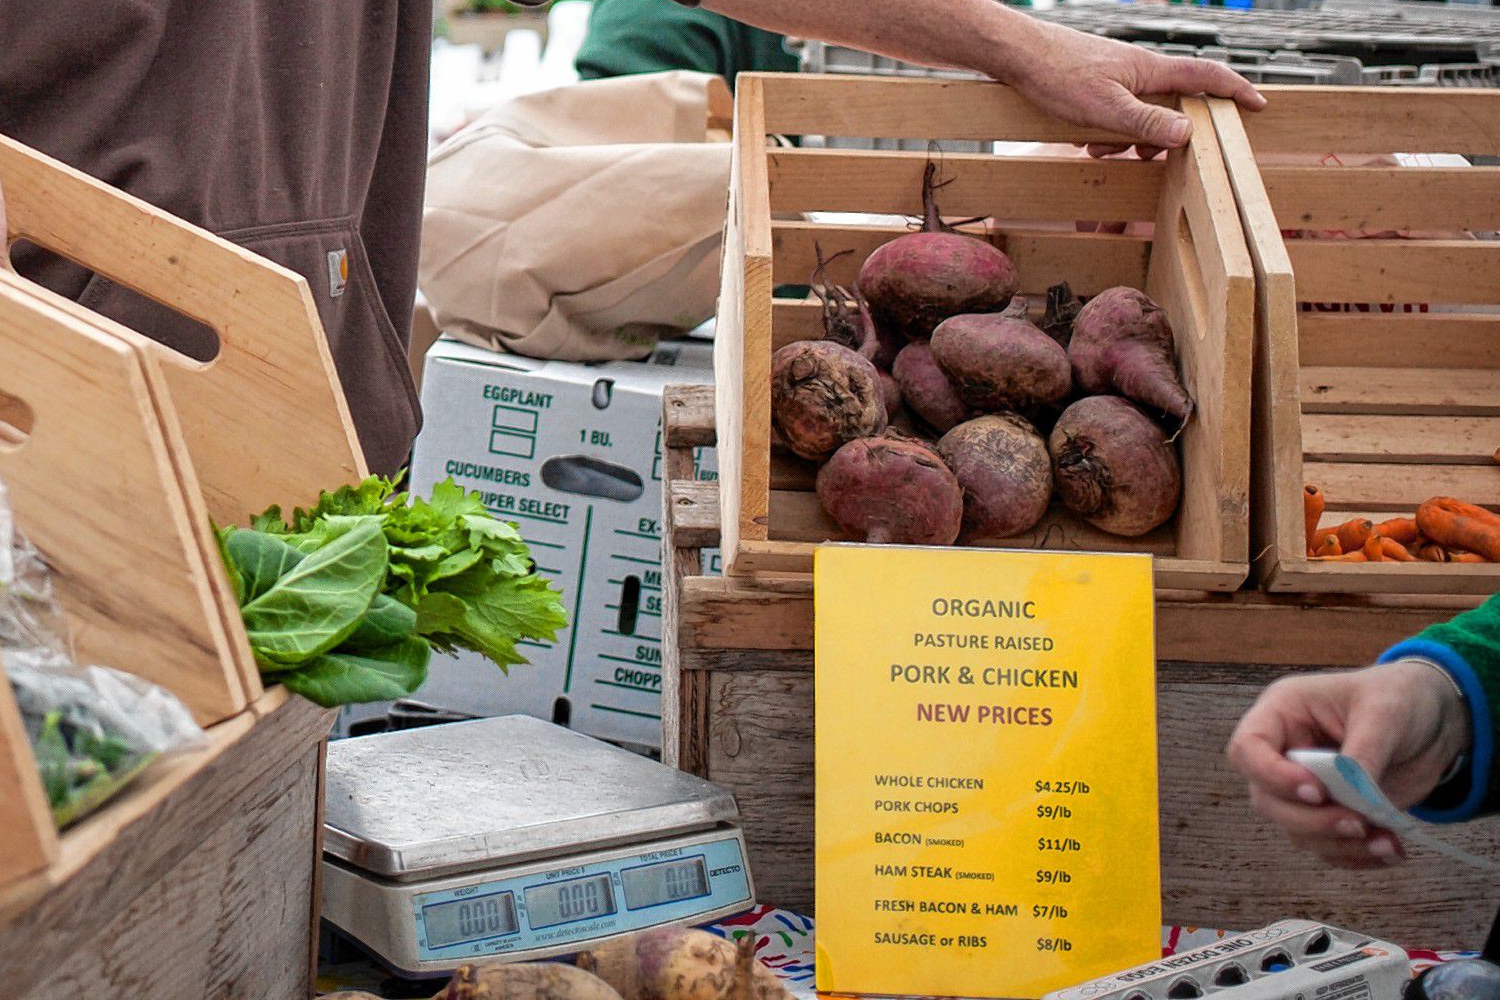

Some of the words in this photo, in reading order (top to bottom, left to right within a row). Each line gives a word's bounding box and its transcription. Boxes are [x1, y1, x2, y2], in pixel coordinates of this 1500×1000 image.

[483, 384, 553, 408] EGGPLANT
[580, 428, 586, 443] 1
[591, 430, 613, 447] BU.
[445, 459, 531, 487] CUCUMBERS
[478, 490, 515, 510] UPER
[519, 498, 570, 519] SELECT
[638, 518, 662, 534] EX-
[643, 570, 662, 586] ME
[931, 597, 1036, 620] ORGANIC
[913, 632, 990, 650] PASTURE
[994, 635, 1054, 652] RAISED
[614, 667, 662, 688] CHOPP
[890, 664, 951, 685] PORK
[957, 667, 975, 686] &
[982, 667, 1079, 689] CHICKEN
[917, 703, 971, 723] NEW
[978, 705, 1054, 727] PRICES
[875, 774, 924, 789] WHOLE
[926, 776, 985, 790] CHICKEN
[1035, 779, 1090, 796] $4.25/lb
[875, 799, 911, 813] PORK
[914, 801, 959, 815] CHOPS
[1036, 805, 1072, 820] $9/lb
[875, 831, 922, 846] BACON
[925, 837, 965, 849] (SMOKED)
[1038, 837, 1081, 853] $11/lb
[709, 864, 741, 878] DETECTO
[875, 864, 907, 878] HAM
[911, 865, 953, 880] STEAK
[955, 870, 996, 882] (SMOKED)
[1036, 869, 1072, 885] $9/lb
[874, 899, 916, 914] FRESH
[919, 901, 967, 916] BACON
[970, 902, 982, 916] &
[985, 904, 1019, 919] HAM
[1032, 904, 1068, 920] $7/lb
[874, 931, 937, 947] SAUSAGE
[940, 937, 955, 948] or
[958, 935, 988, 949] RIBS
[1036, 937, 1073, 953] $8/lb
[1222, 939, 1253, 954] ONE
[1163, 949, 1222, 970] DOZEN
[1116, 964, 1162, 982] EGGS
